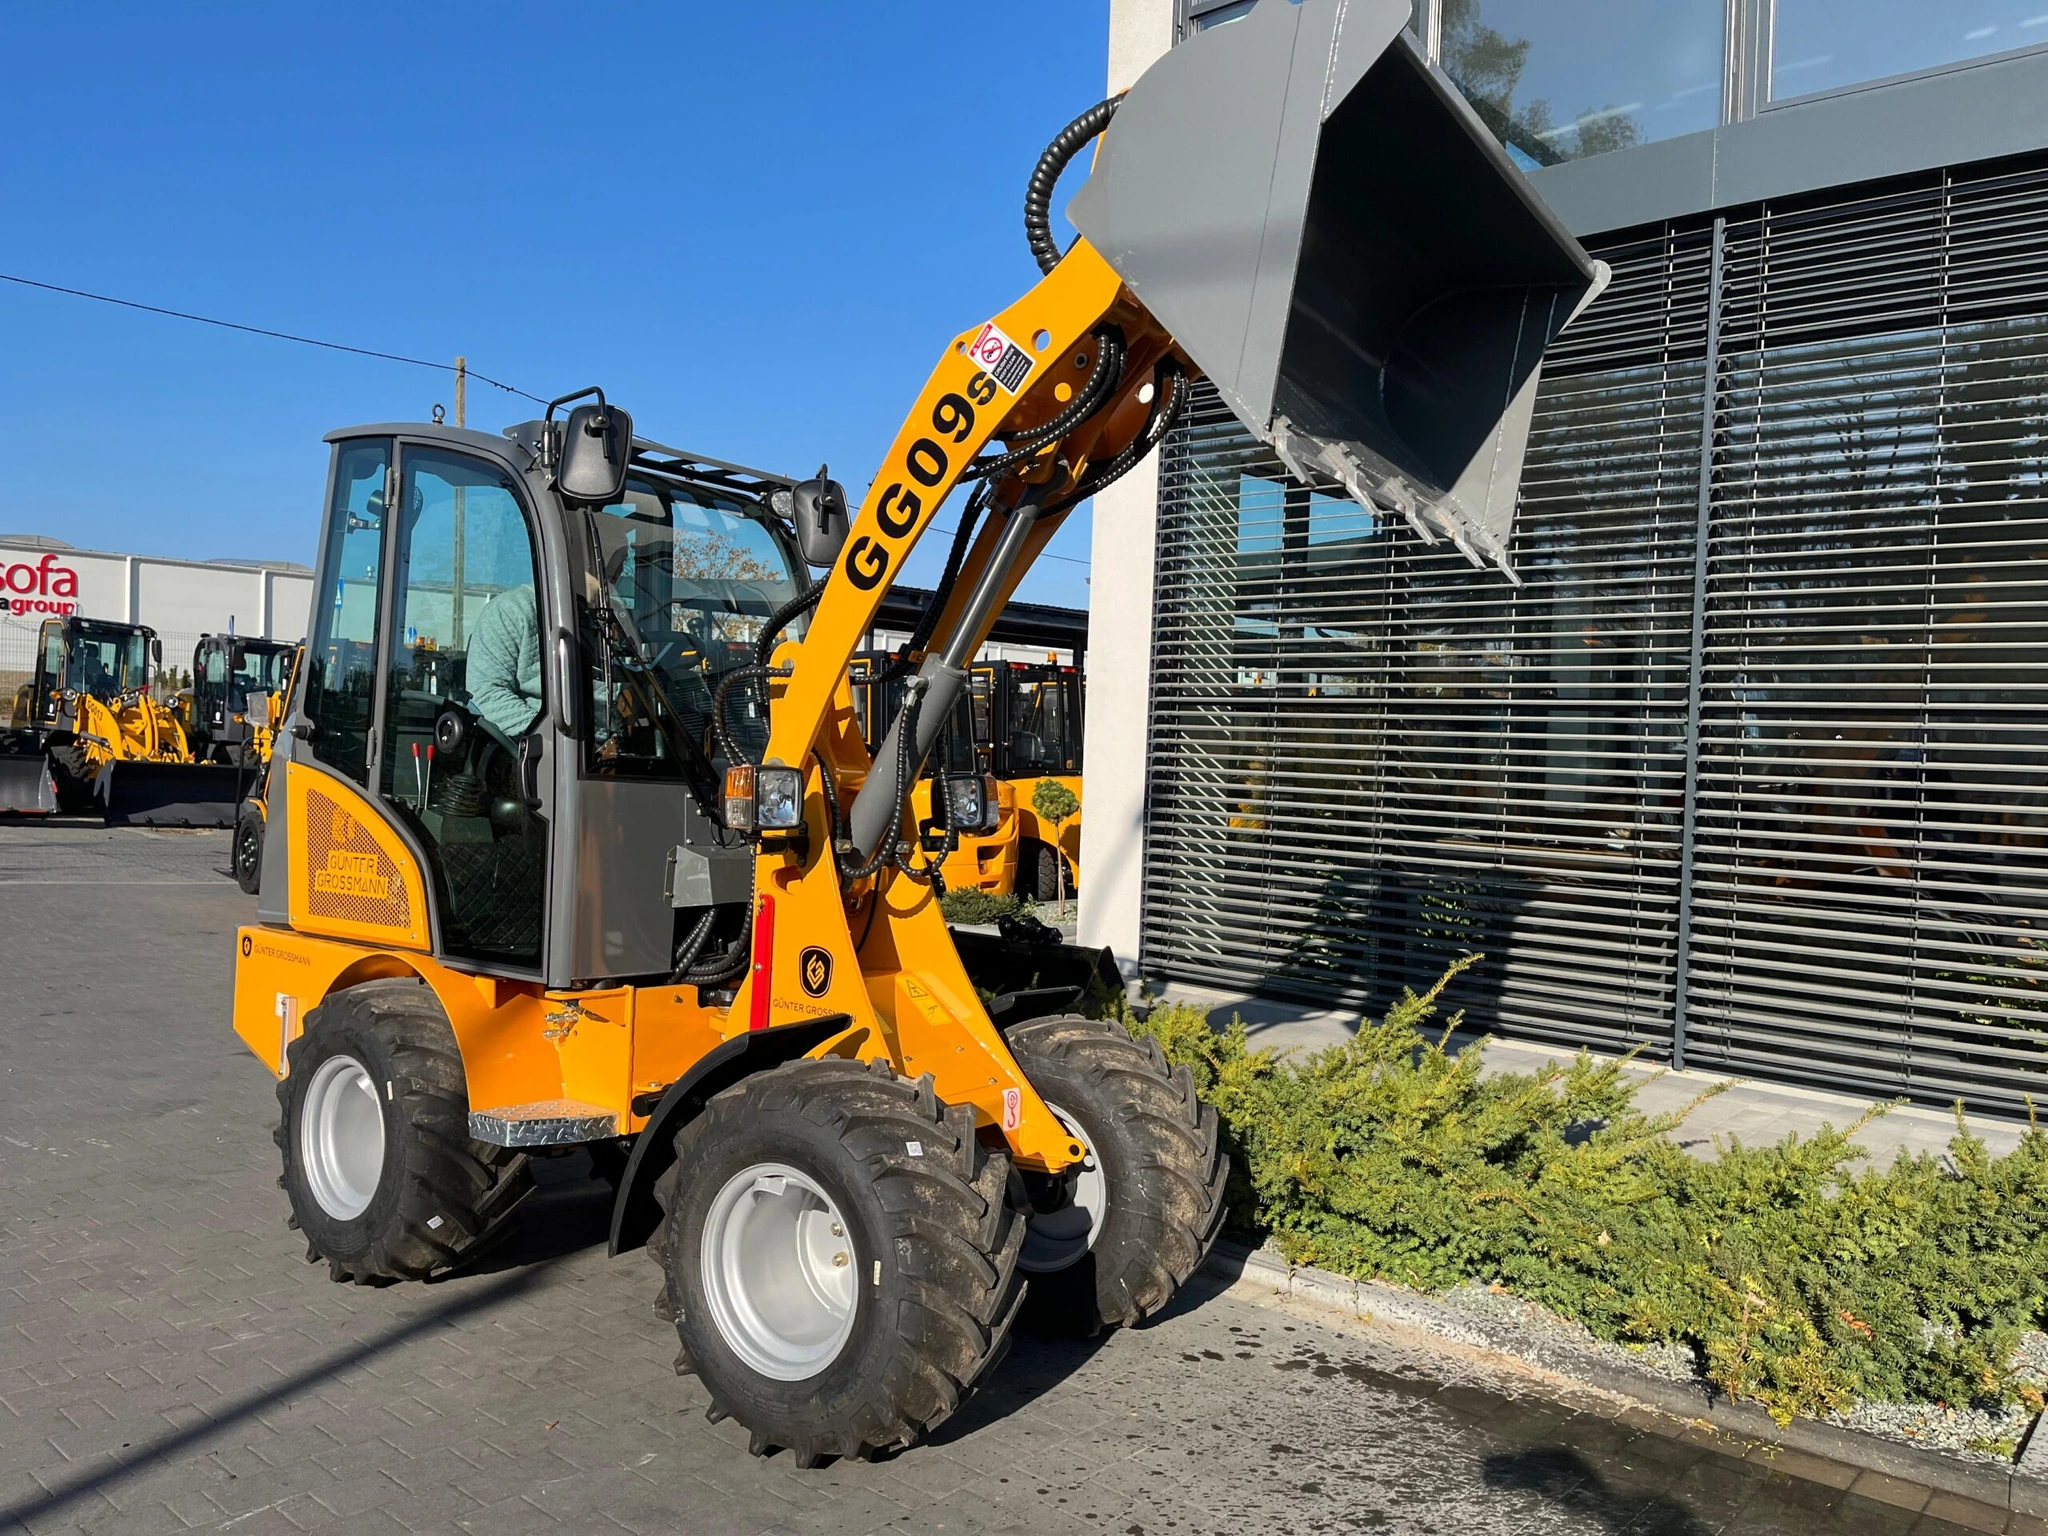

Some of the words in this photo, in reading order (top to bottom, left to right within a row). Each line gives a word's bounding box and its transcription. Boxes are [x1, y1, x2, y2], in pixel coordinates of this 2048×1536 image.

[0, 553, 78, 598] ofa
[330, 852, 374, 874] GÜNTER
[317, 873, 386, 895] GROSSMANN
[773, 998, 804, 1012] GÜNTER
